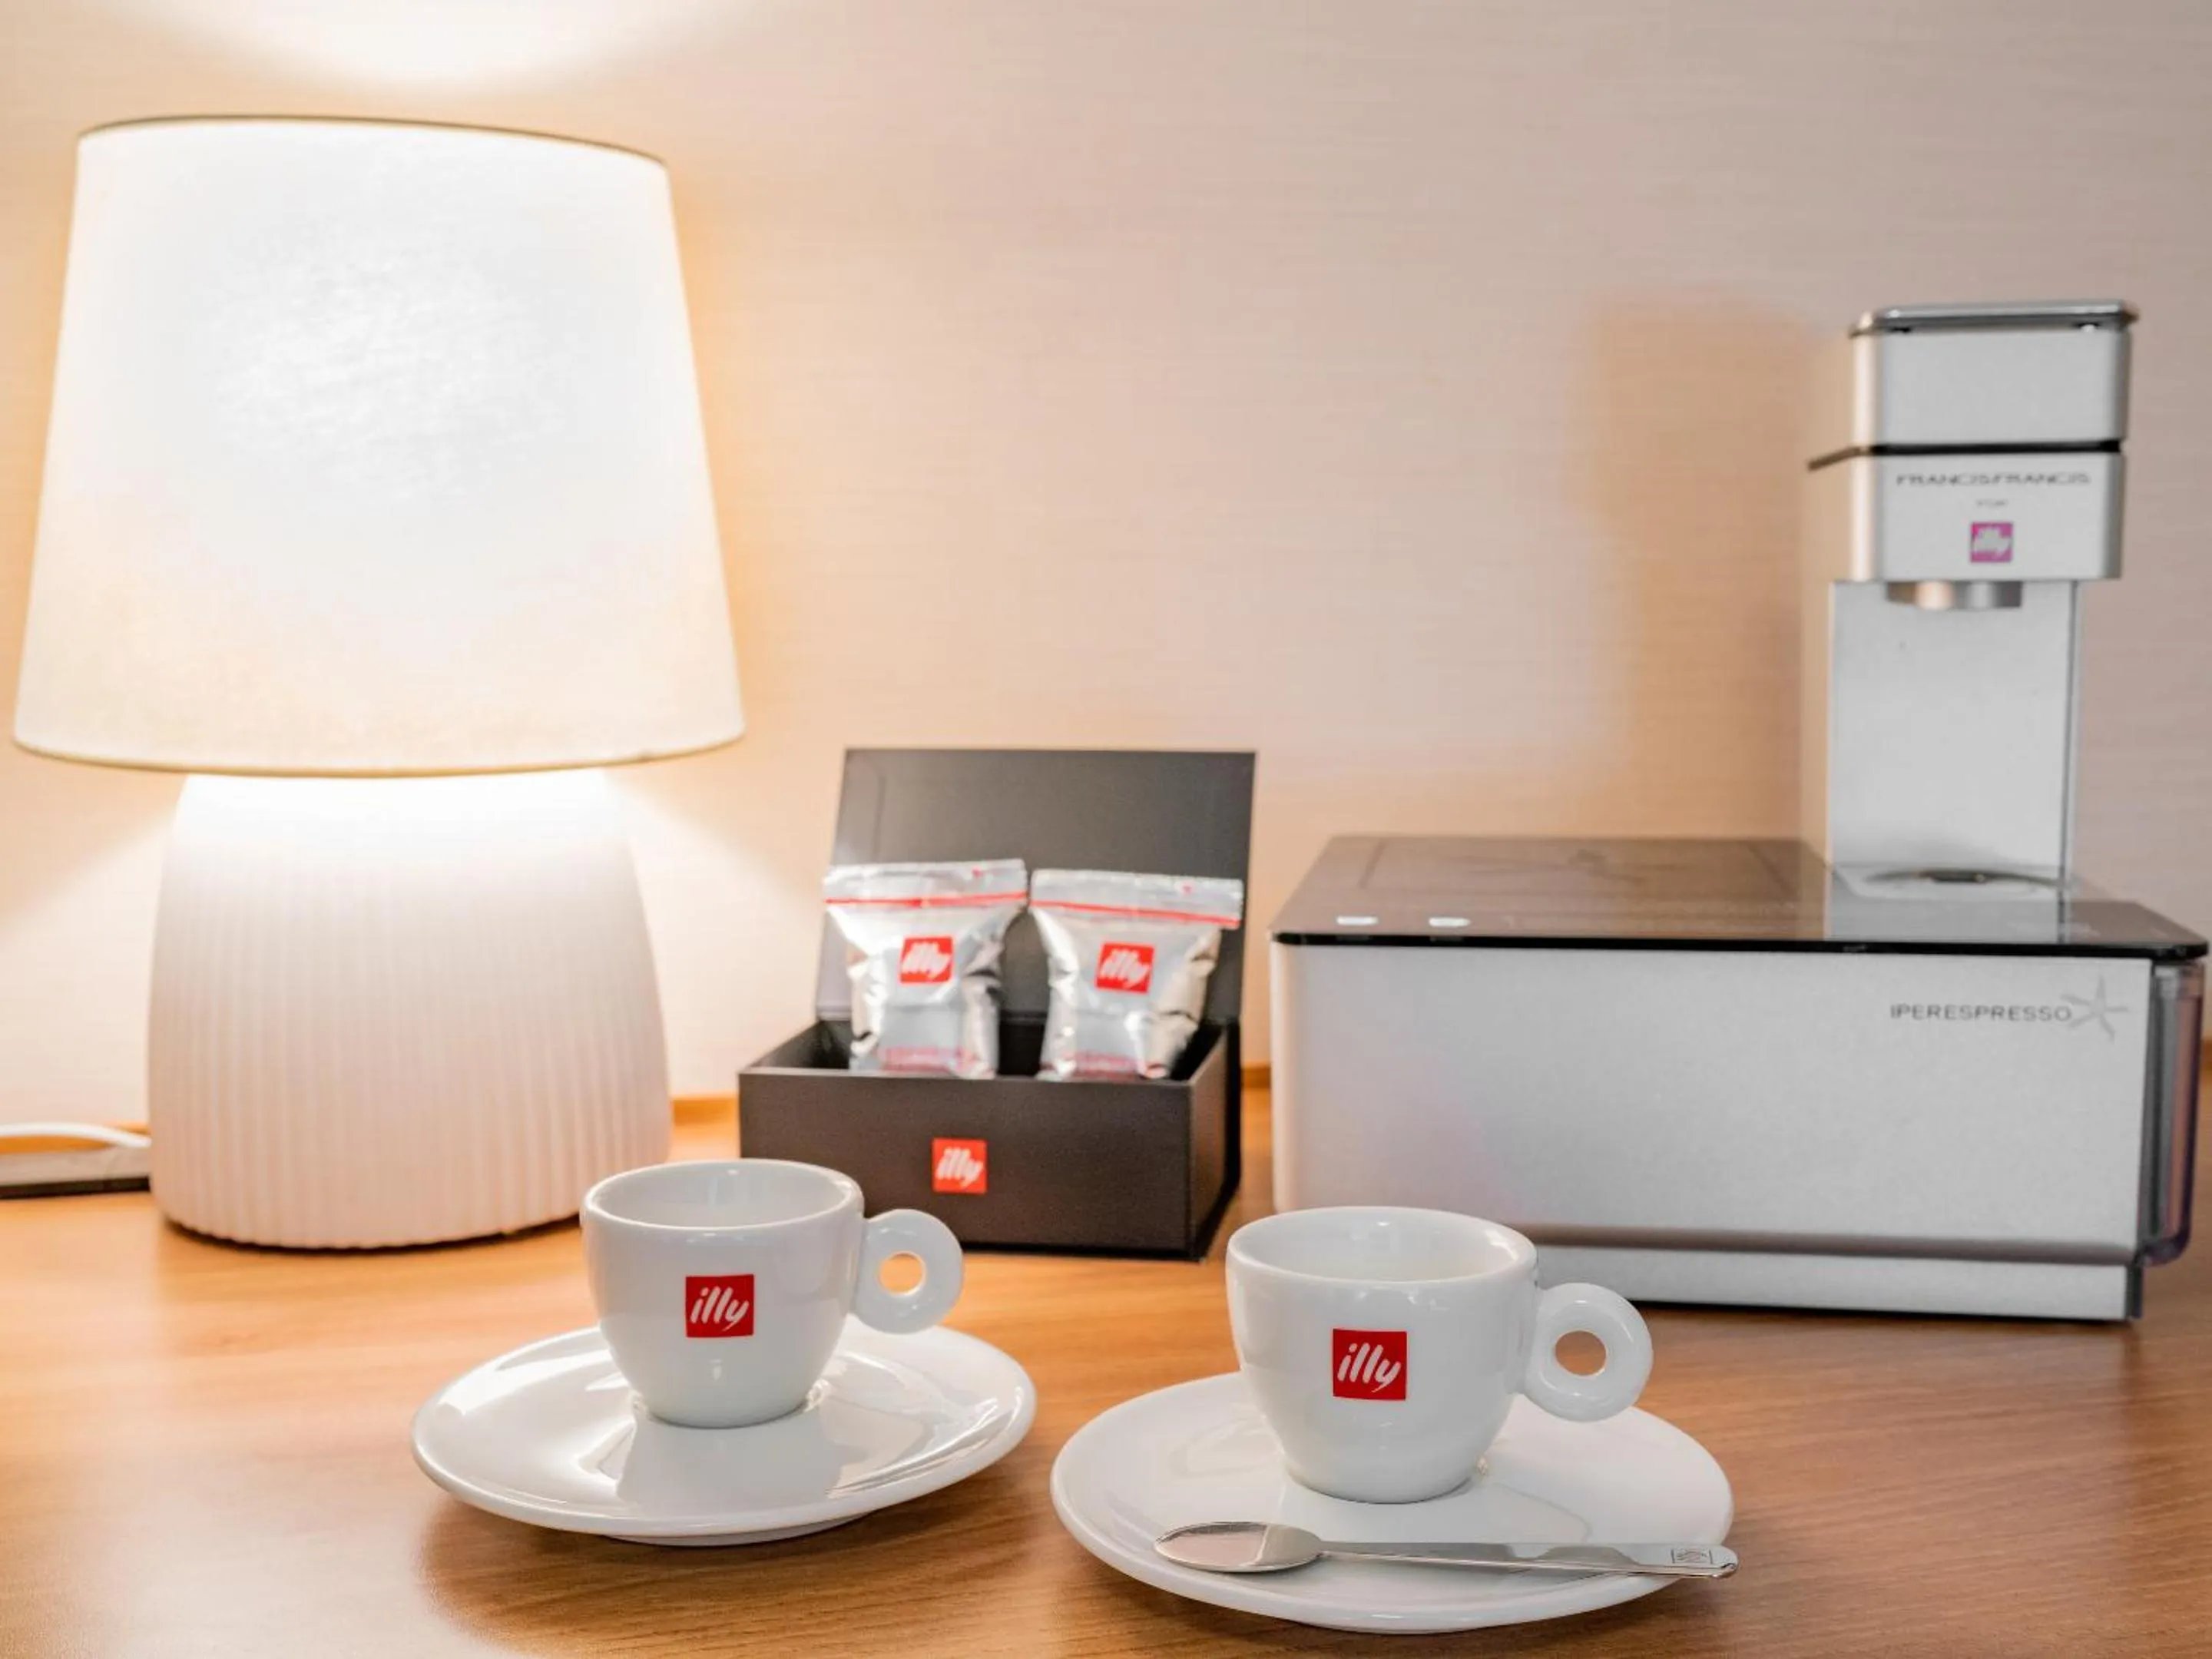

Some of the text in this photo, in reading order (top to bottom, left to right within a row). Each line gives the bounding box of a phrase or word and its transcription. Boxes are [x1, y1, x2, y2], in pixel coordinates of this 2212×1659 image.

[902, 942, 950, 979] illy
[1100, 948, 1151, 987] illy
[1889, 1003, 2073, 1022] IPERESPRESSO
[935, 1147, 983, 1187] illy
[690, 1286, 749, 1332] illy
[1337, 1342, 1402, 1393] illy
